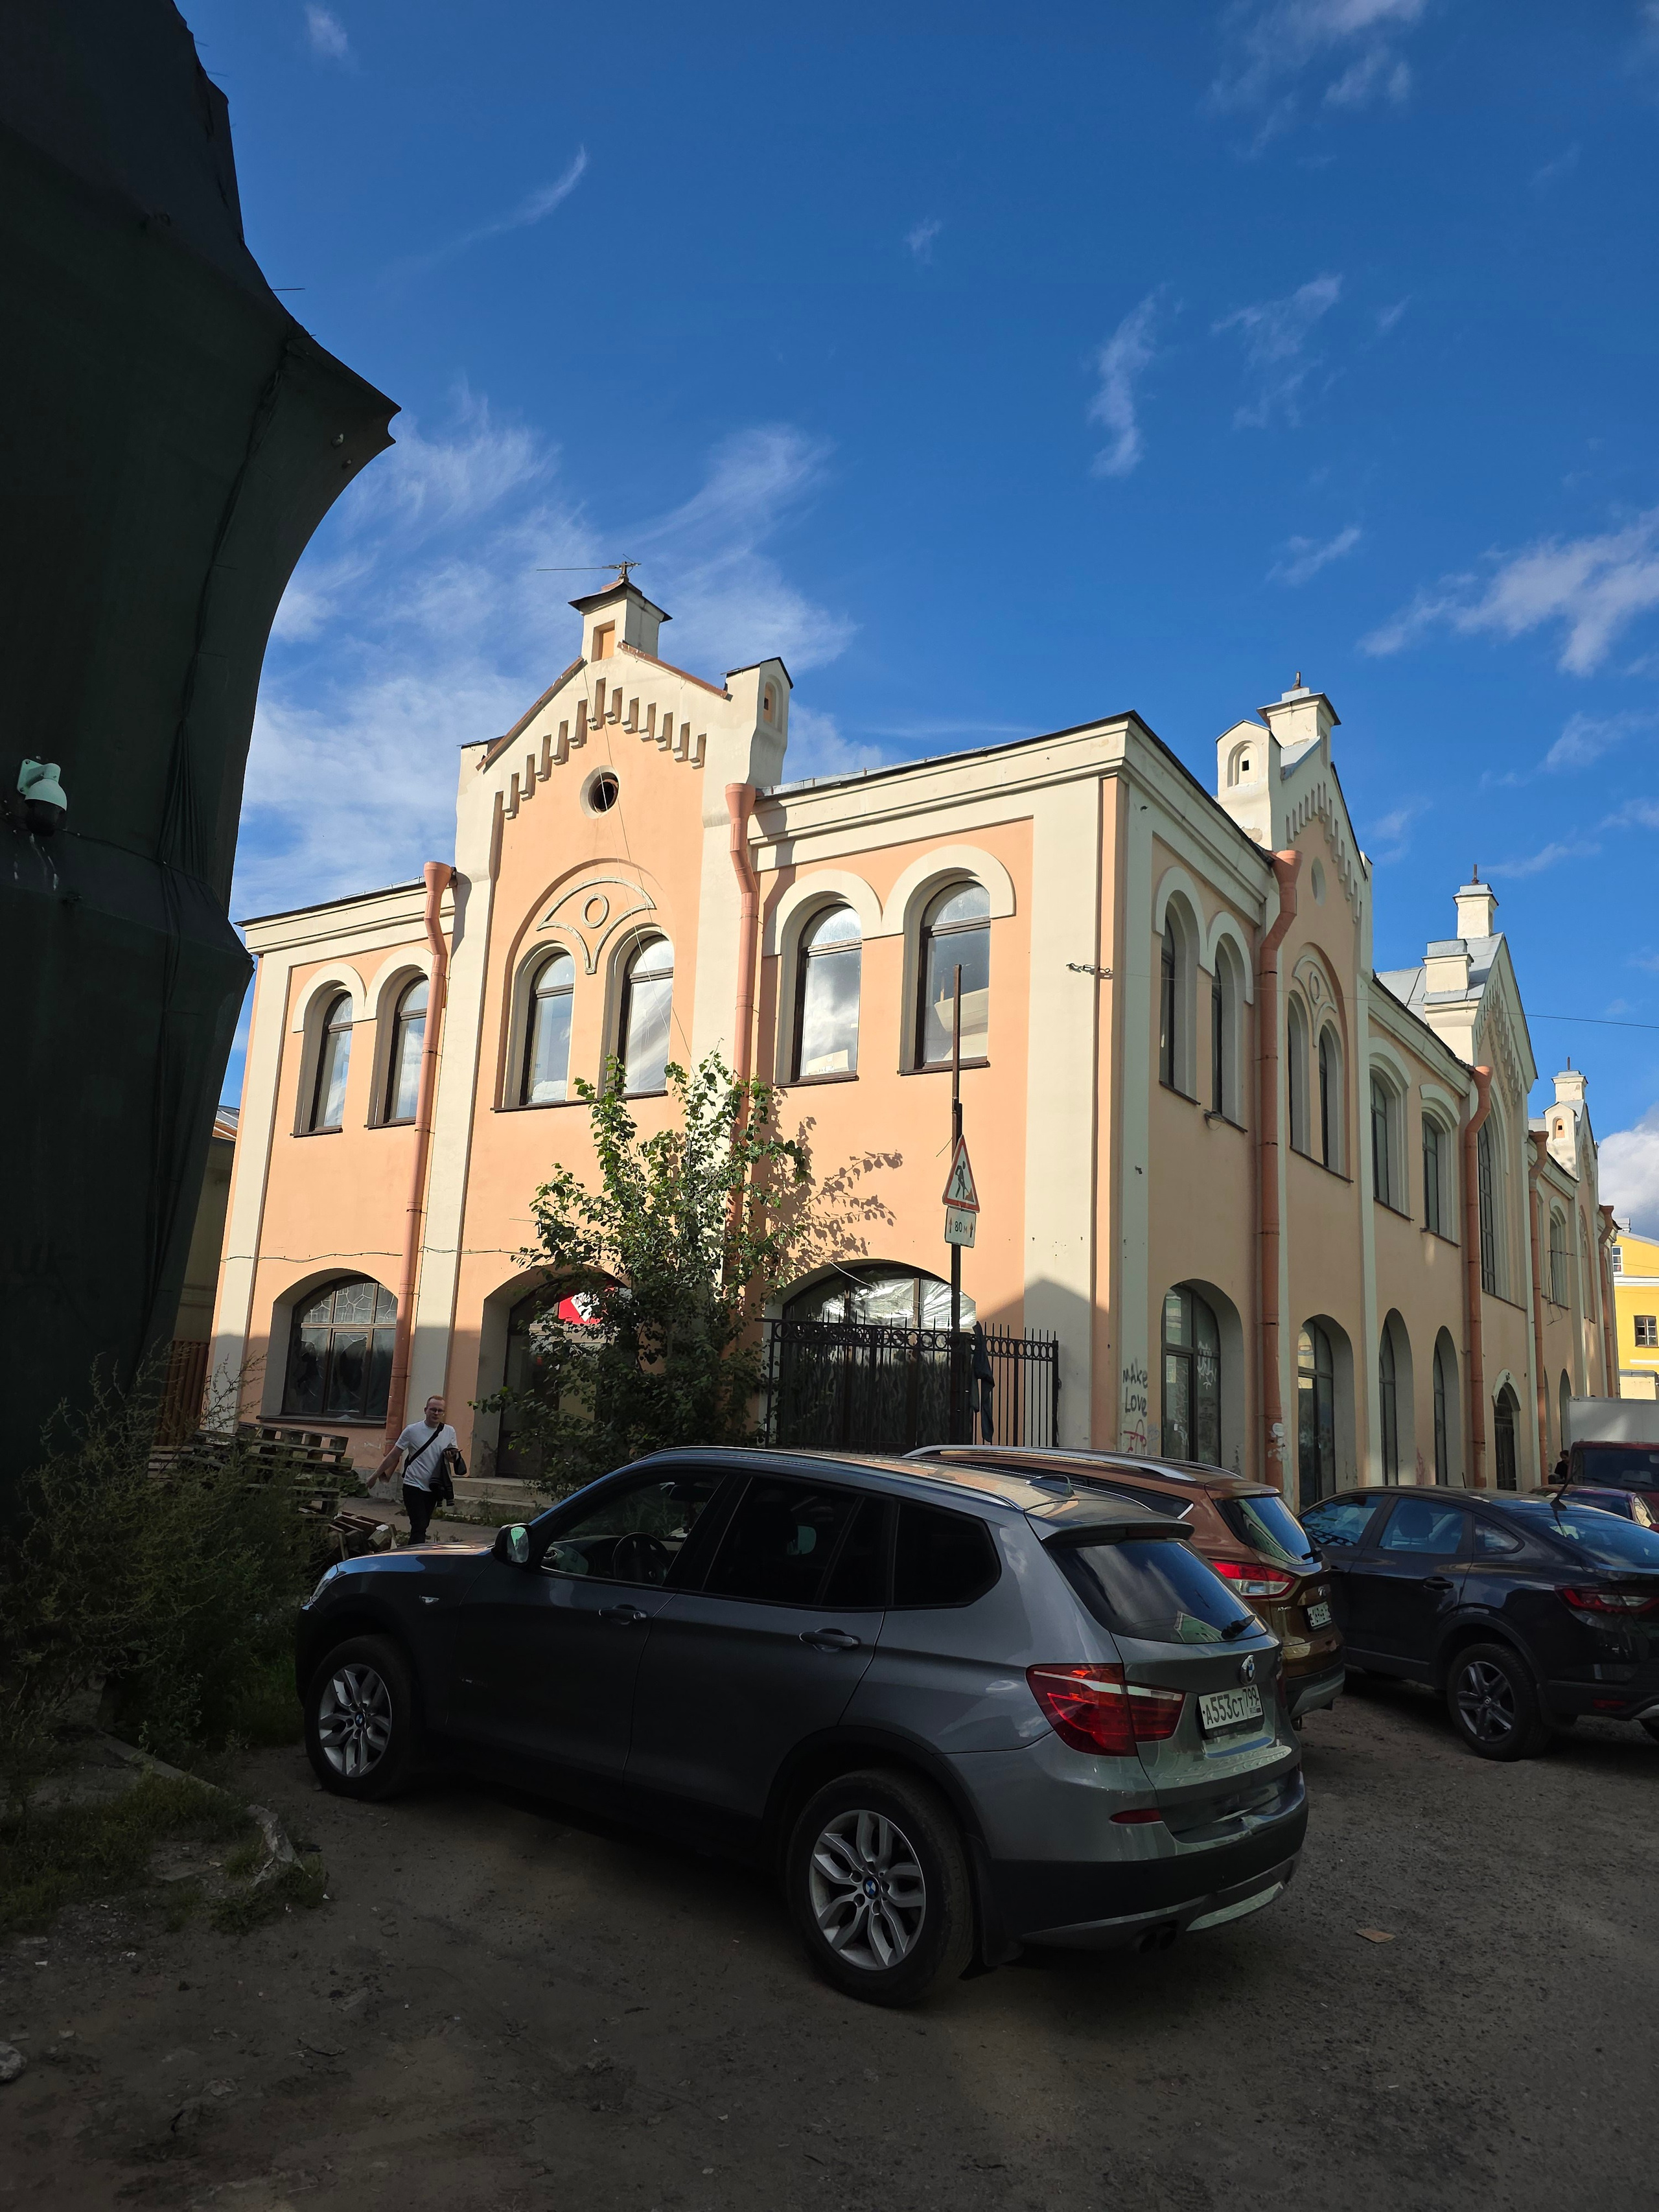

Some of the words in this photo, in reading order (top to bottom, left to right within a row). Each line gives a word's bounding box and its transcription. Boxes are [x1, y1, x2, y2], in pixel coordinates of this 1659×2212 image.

[955, 1221, 962, 1232] 80
[1205, 1694, 1244, 1725] A553CT
[1242, 1686, 1258, 1707] 799
